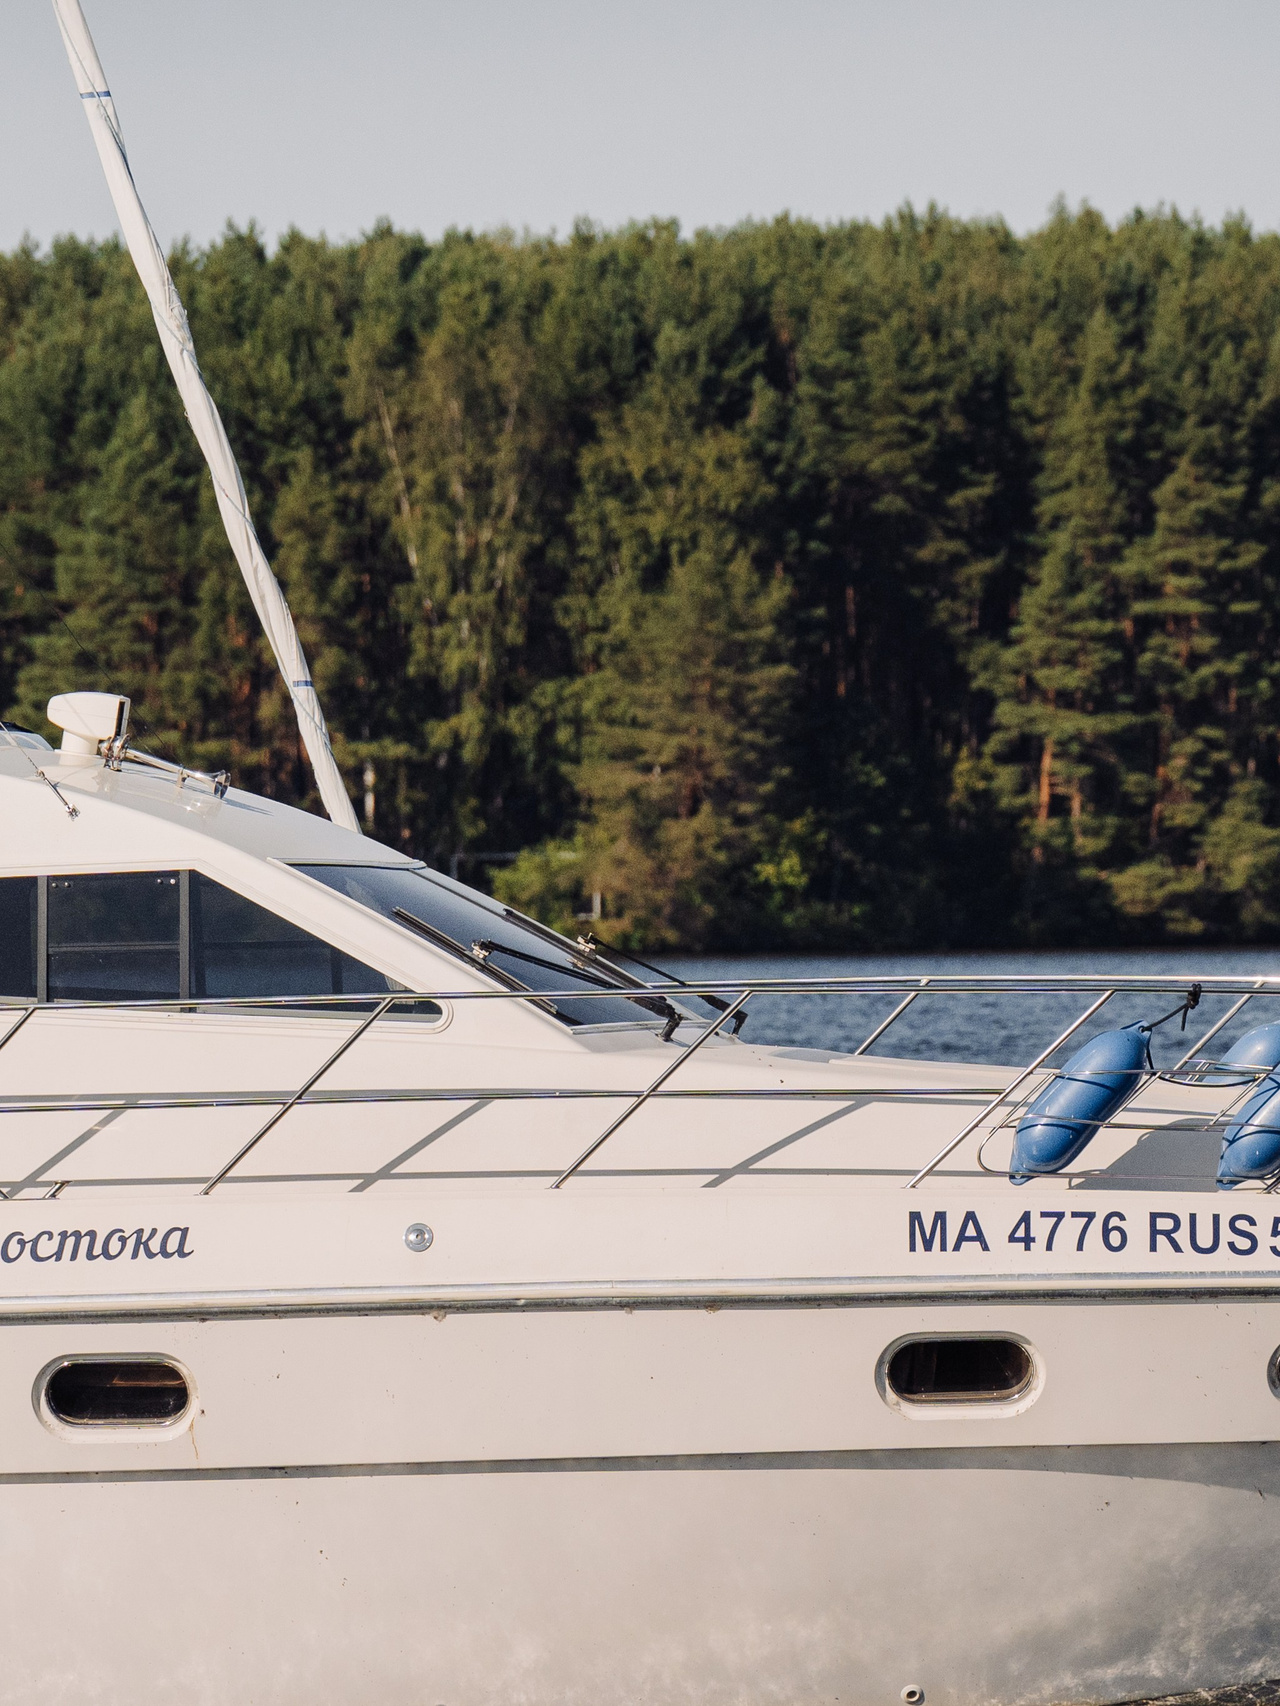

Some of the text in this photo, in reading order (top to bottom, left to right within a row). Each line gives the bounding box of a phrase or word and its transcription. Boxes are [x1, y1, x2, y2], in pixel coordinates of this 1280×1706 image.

[0, 1226, 194, 1264] остока
[908, 1210, 991, 1253] MA
[1007, 1210, 1128, 1253] 4776
[1149, 1211, 1259, 1256] RUS
